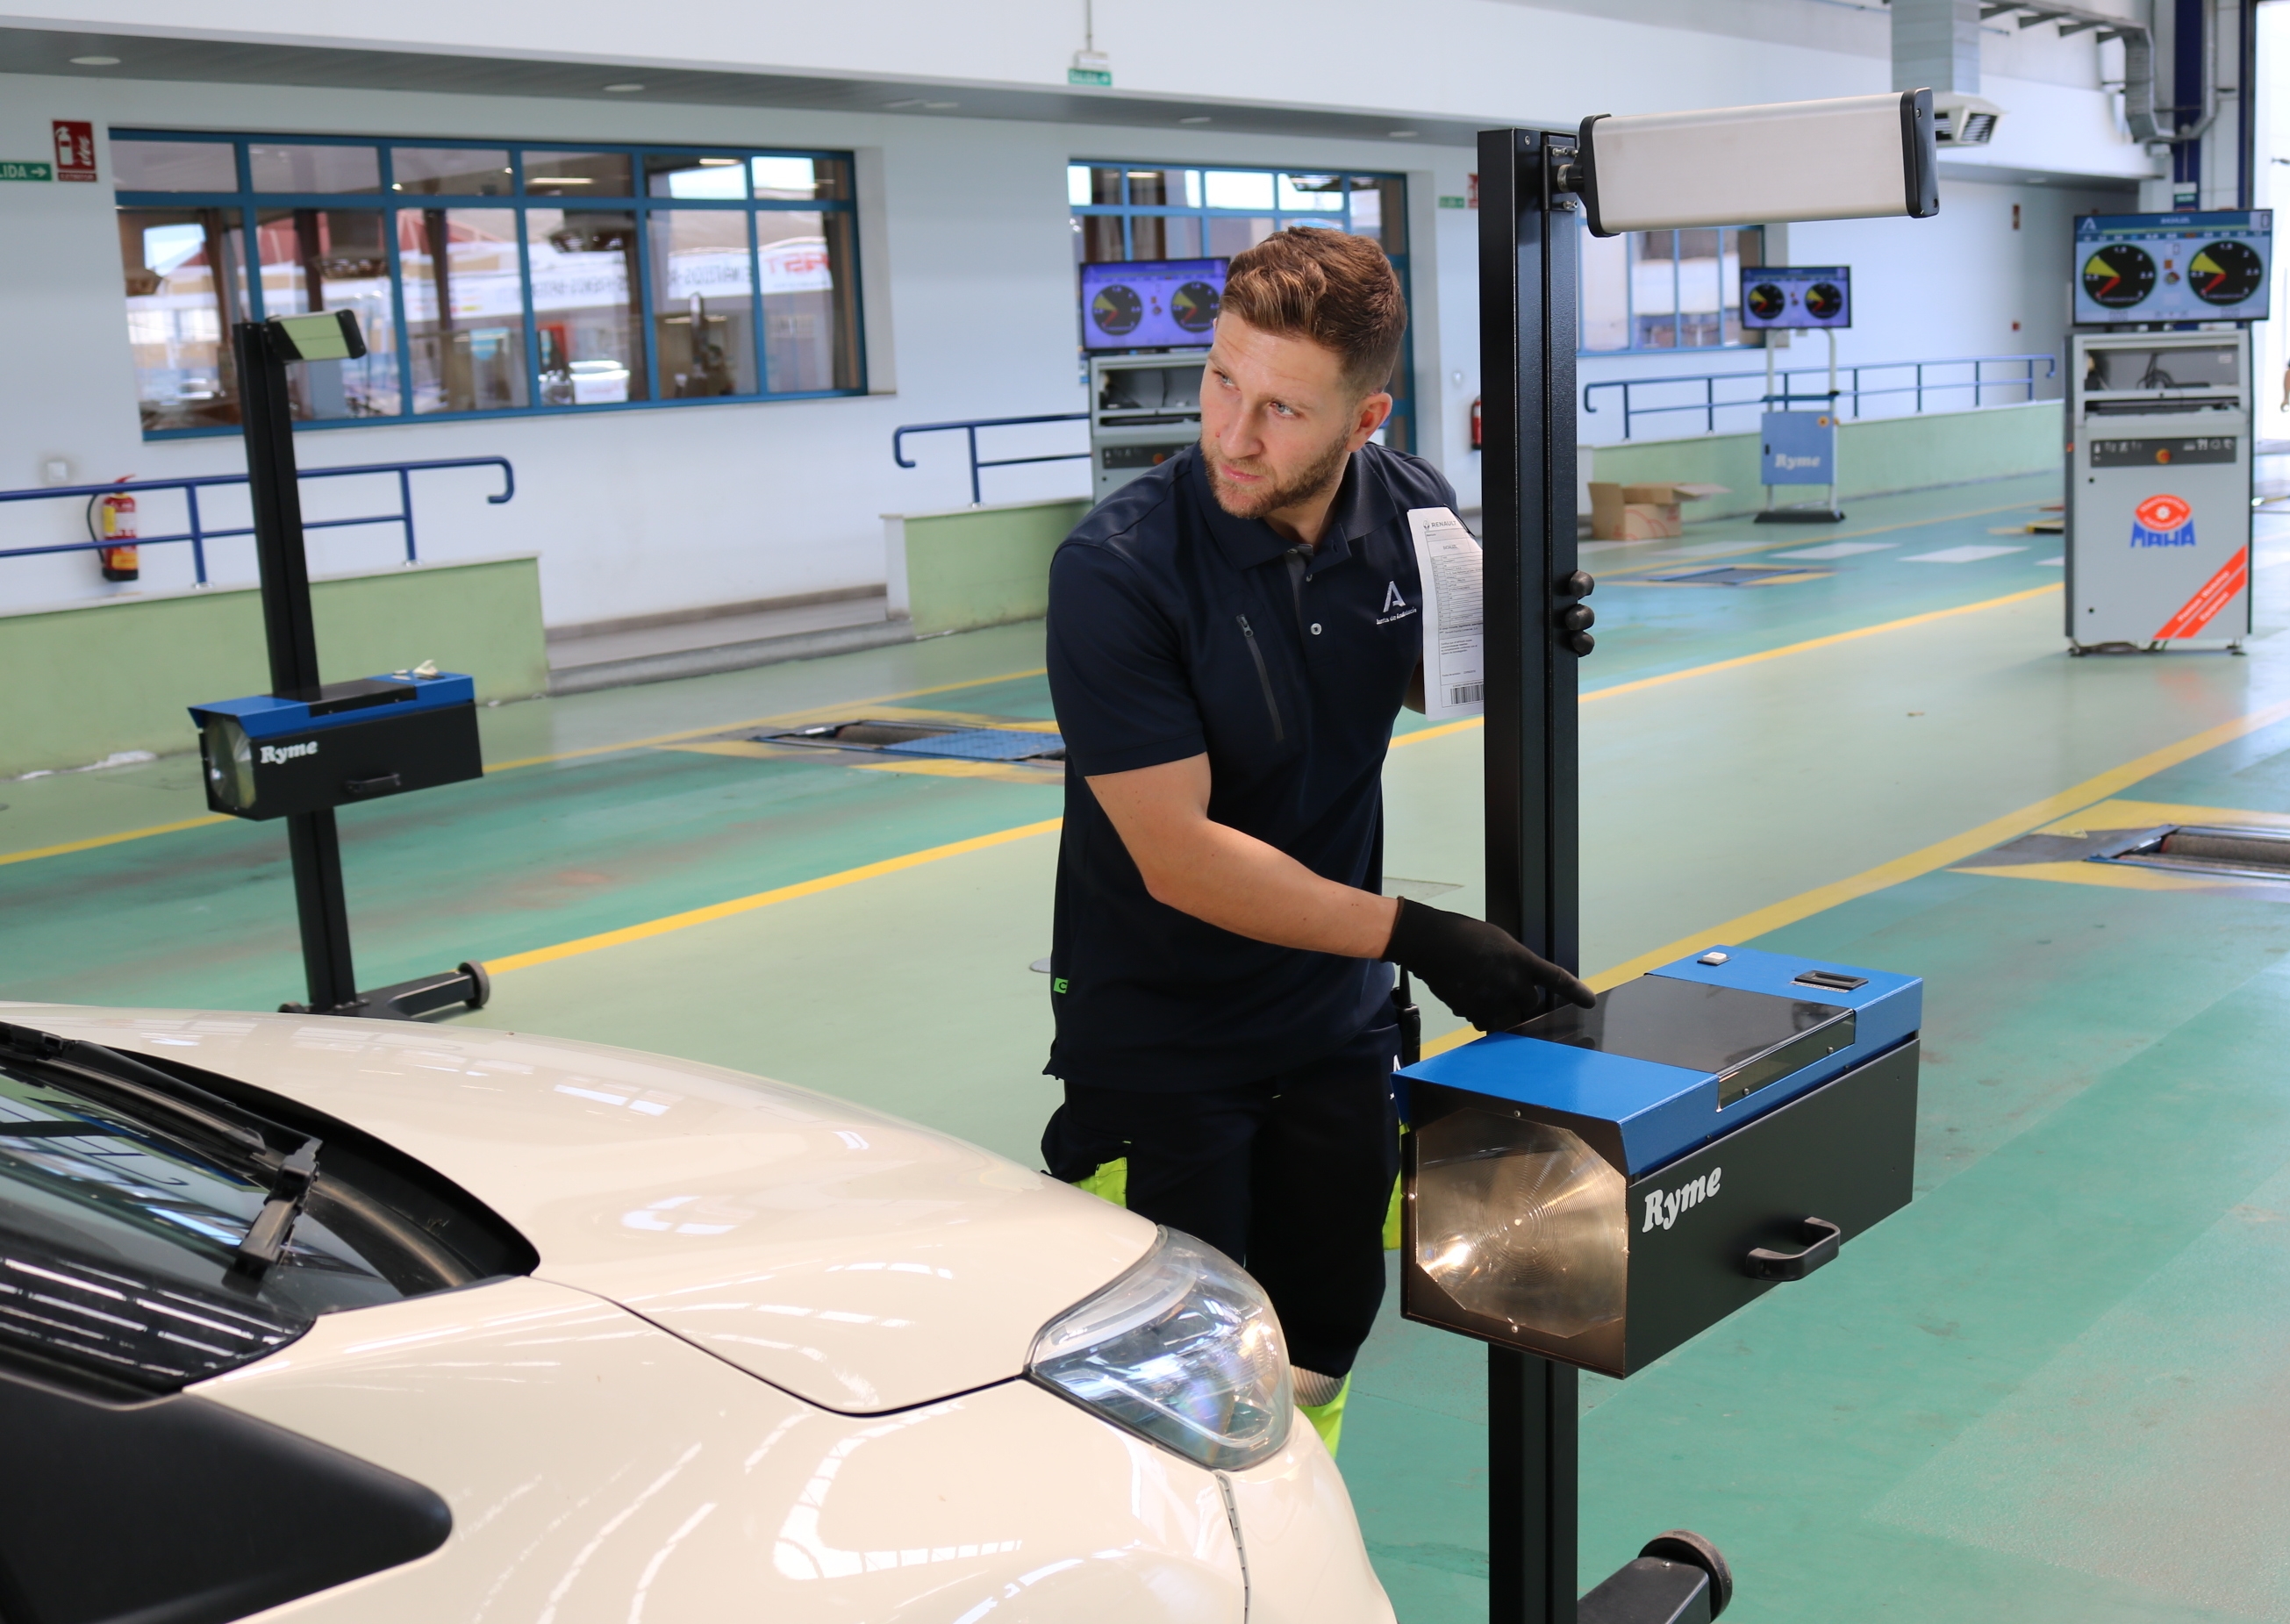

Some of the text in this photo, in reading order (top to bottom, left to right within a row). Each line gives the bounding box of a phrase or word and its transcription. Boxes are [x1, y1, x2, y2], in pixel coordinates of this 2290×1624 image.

[0, 165, 27, 178] IDA
[1774, 454, 1821, 471] Ryme
[2130, 519, 2197, 548] MAHA
[260, 740, 318, 765] Ryme
[1642, 1167, 1722, 1234] Ryme
